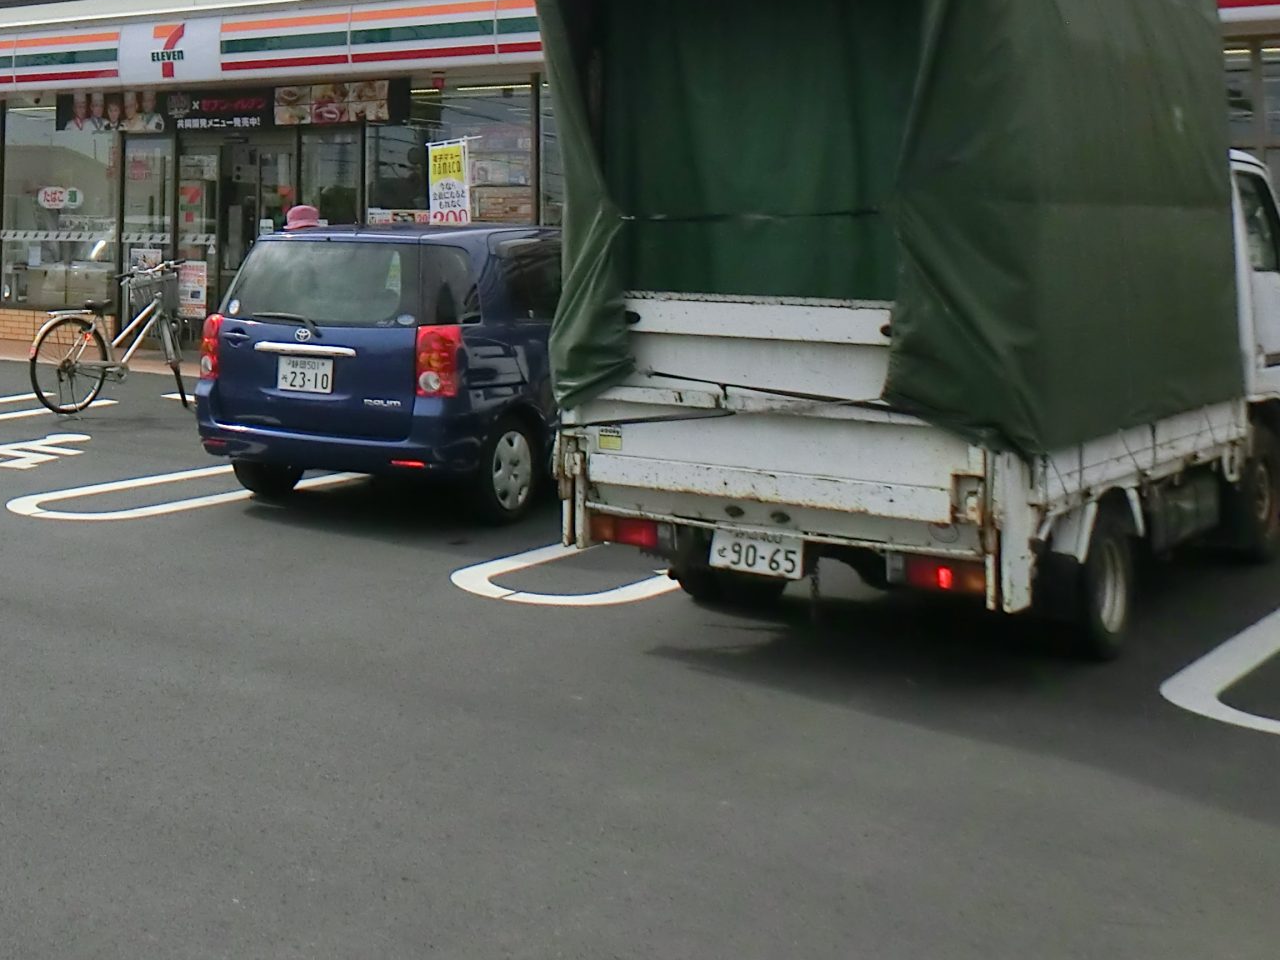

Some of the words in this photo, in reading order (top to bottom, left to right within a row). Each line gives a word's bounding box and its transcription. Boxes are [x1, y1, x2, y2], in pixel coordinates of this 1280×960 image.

[153, 23, 185, 78] 7
[43, 190, 64, 203] たばこ
[730, 542, 797, 574] 90-65
